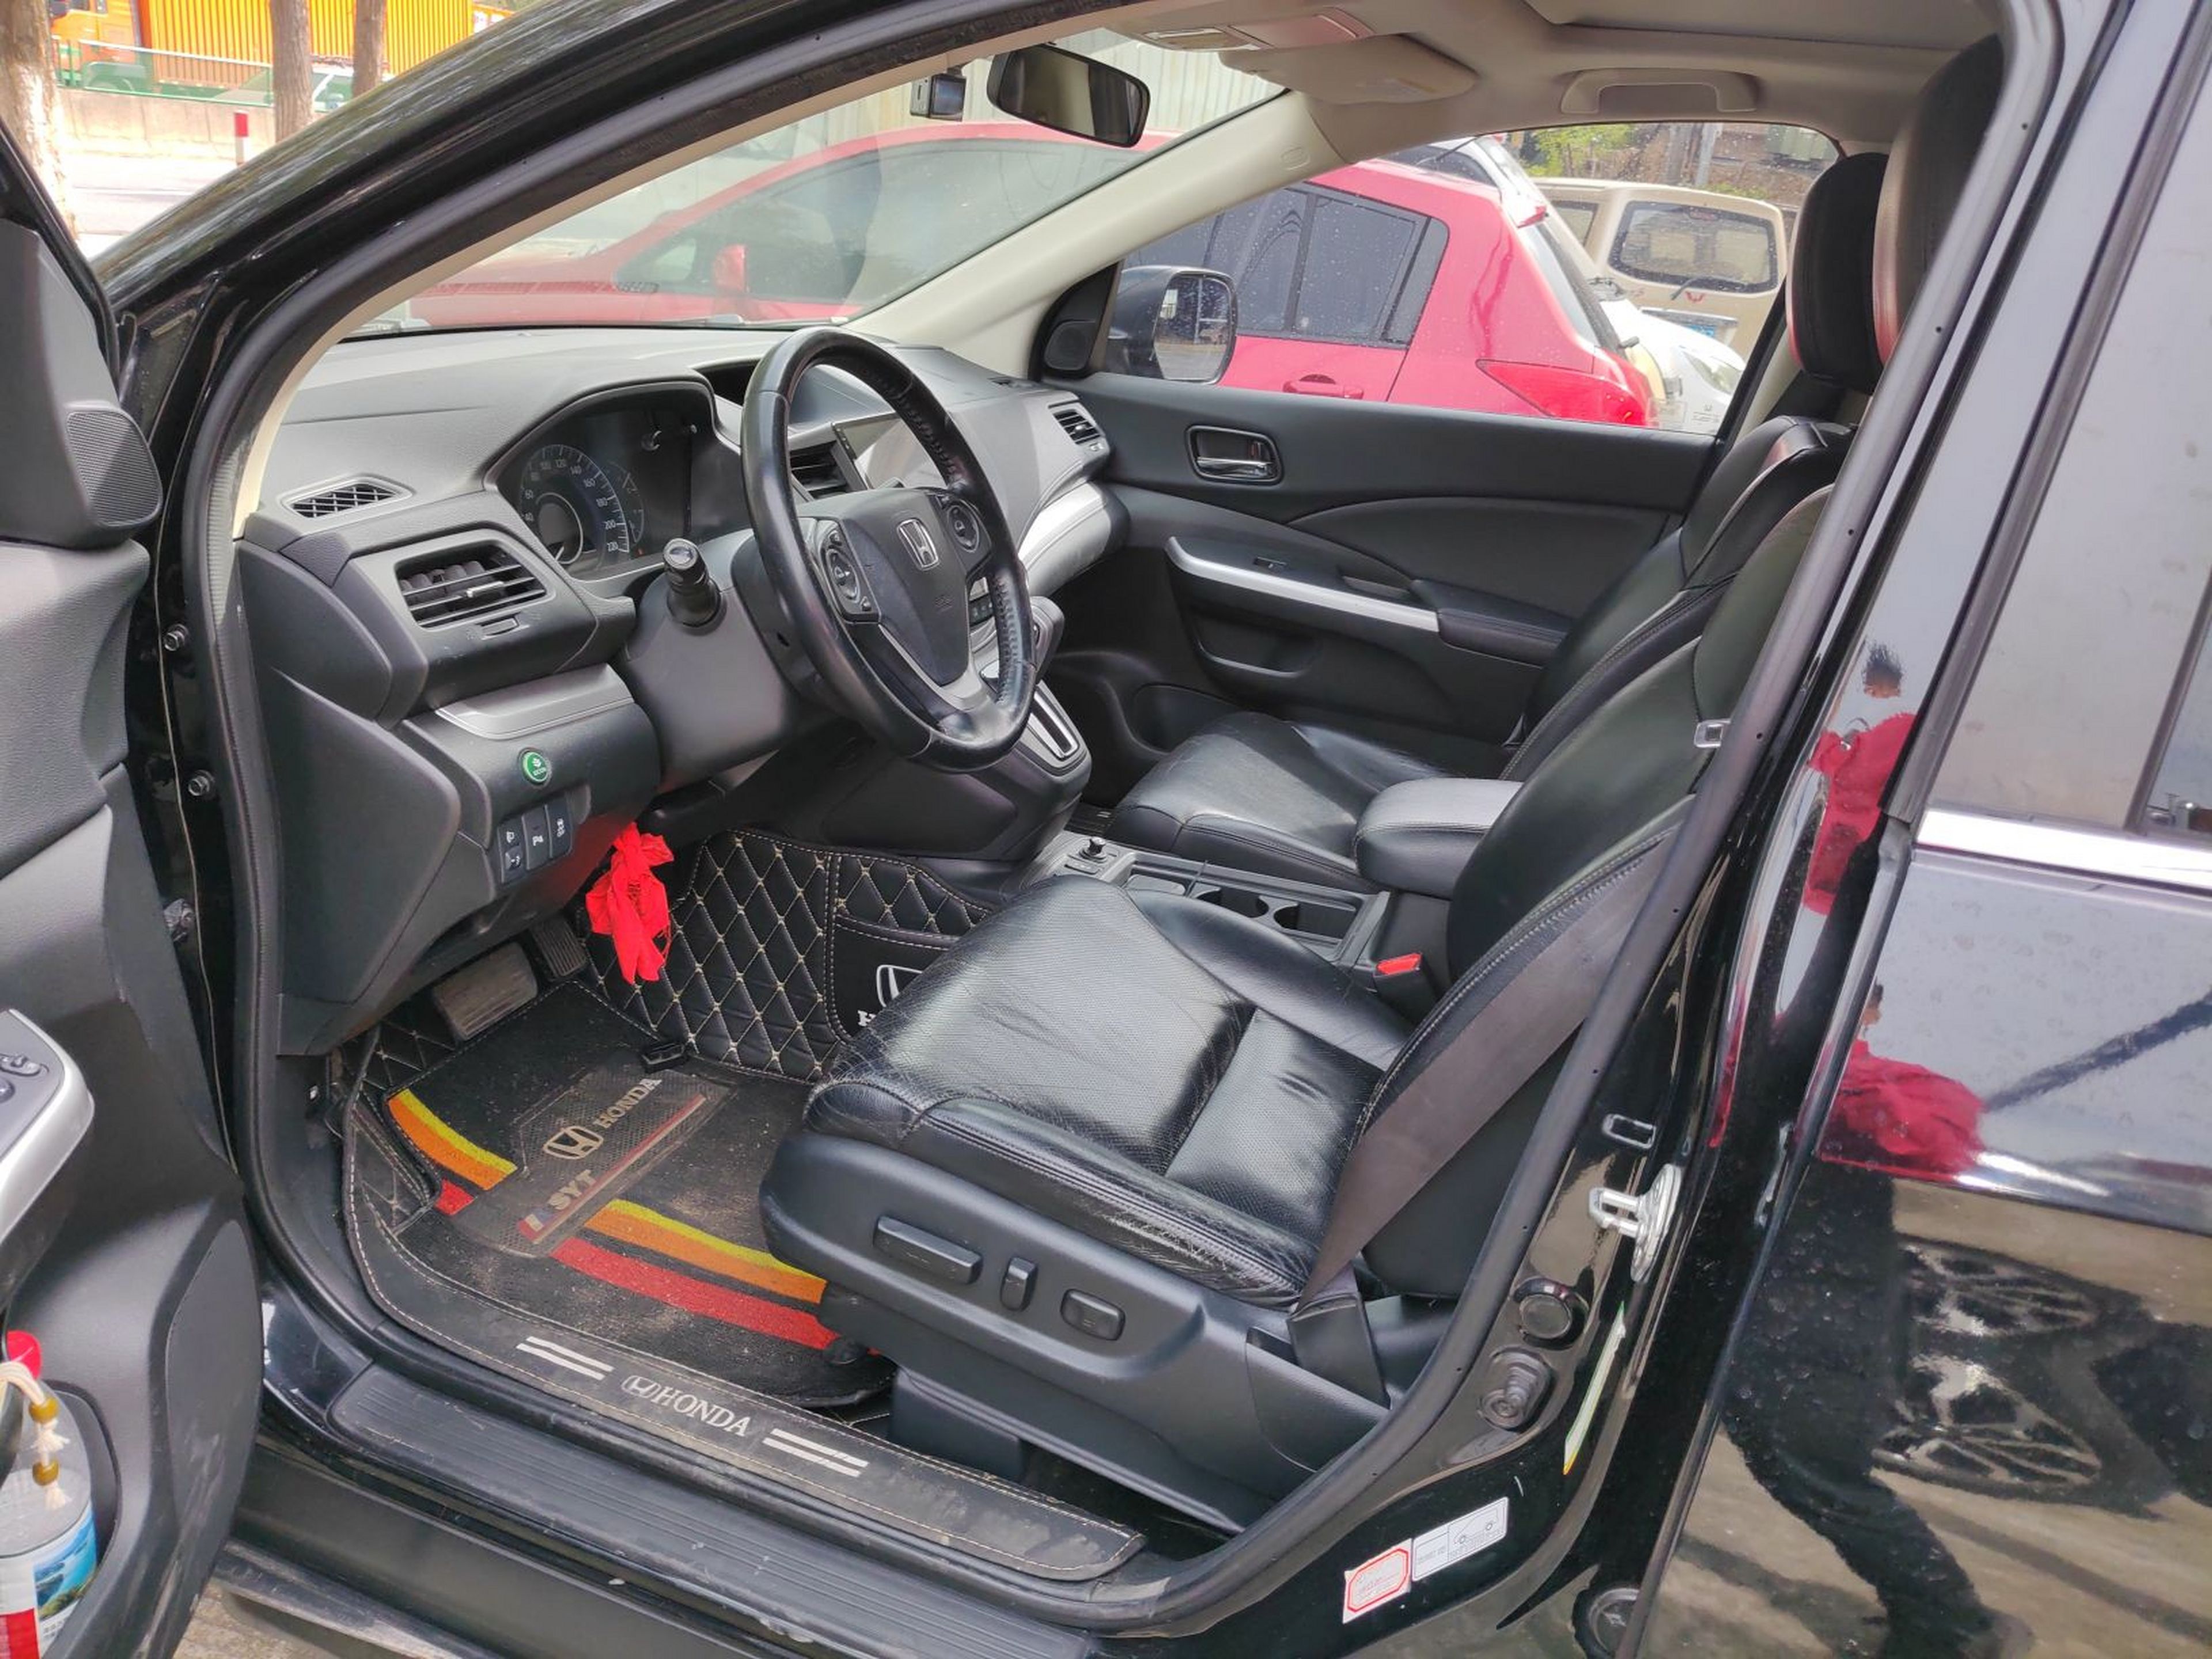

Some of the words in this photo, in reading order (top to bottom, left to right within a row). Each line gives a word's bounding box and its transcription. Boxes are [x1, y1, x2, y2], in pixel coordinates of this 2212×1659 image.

[583, 478, 596, 488] 160
[596, 497, 608, 507] 180
[604, 520, 616, 529] 200
[593, 1078, 662, 1128] HONDA
[548, 1169, 597, 1210] SYT
[651, 1385, 751, 1437] HONDA
